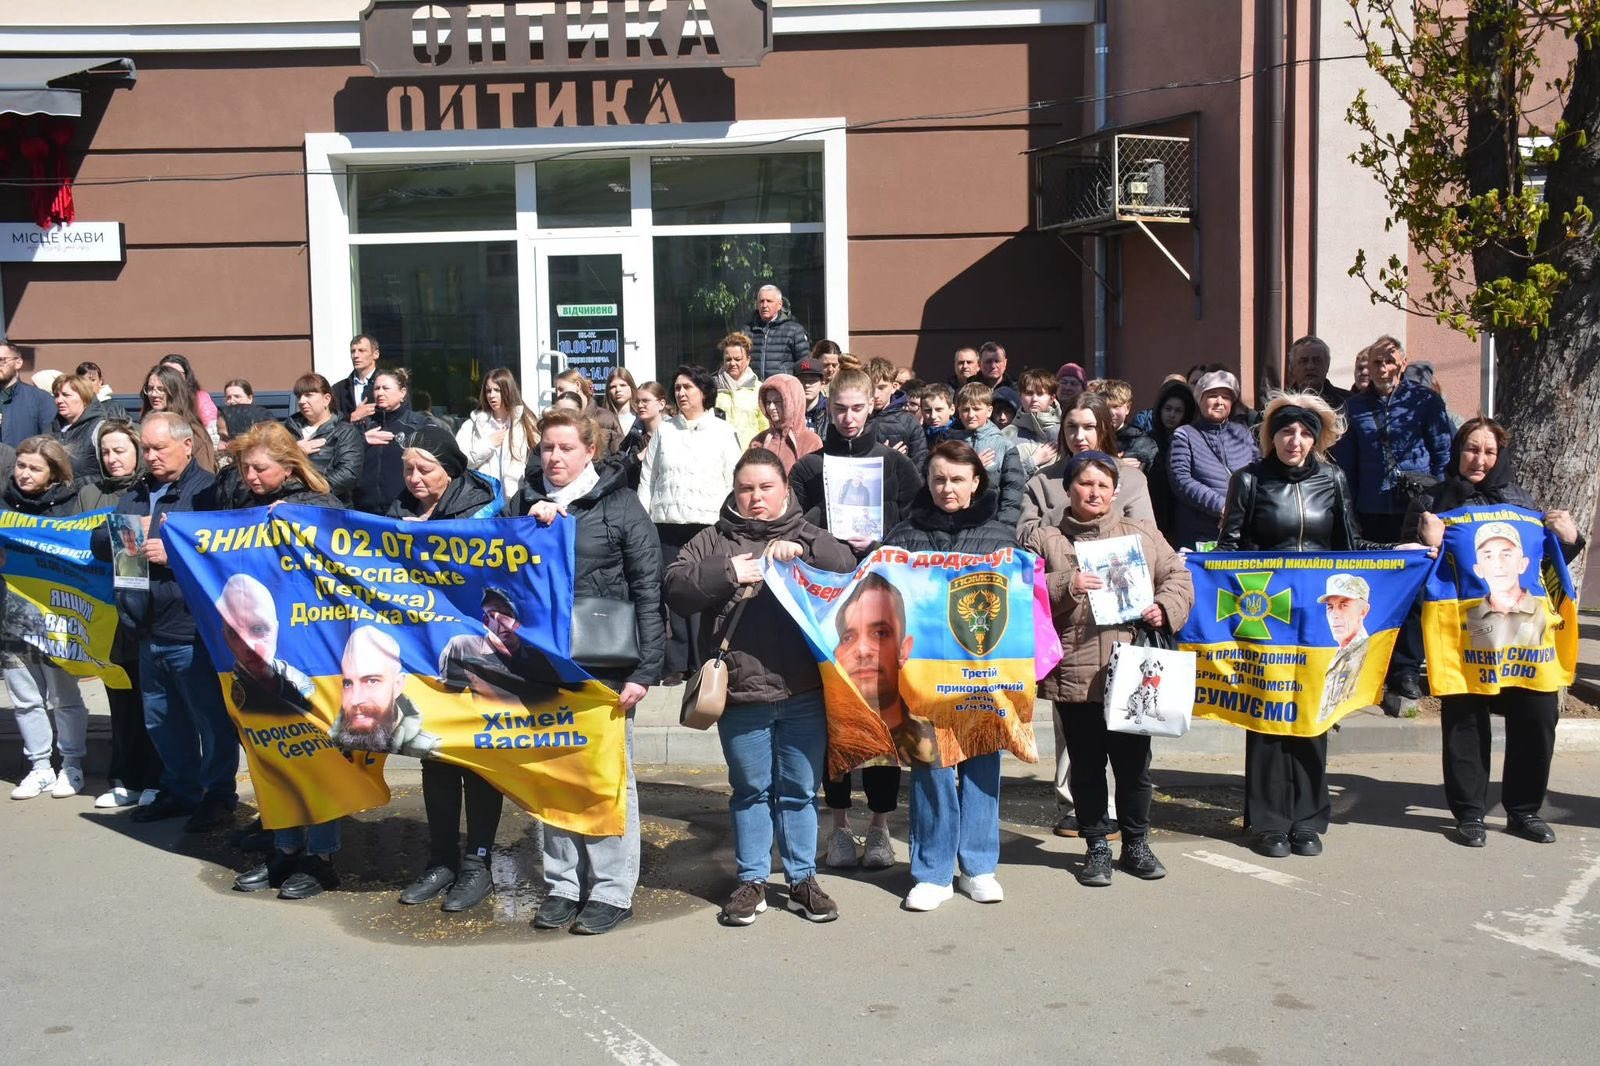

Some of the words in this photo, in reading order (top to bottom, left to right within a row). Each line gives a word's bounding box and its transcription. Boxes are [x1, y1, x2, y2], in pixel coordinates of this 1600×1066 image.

[411, 1, 721, 66] ОПТИКА
[12, 232, 59, 245] МІСЦЕ
[64, 232, 104, 244] КАВИ
[562, 305, 614, 315] ВІДЧИНЕНО
[194, 519, 318, 554] ЗНИКЛИ
[280, 555, 301, 572] с.
[304, 551, 467, 587] Новоспаське
[1285, 556, 1334, 570] МИХАЙЛО
[1335, 558, 1406, 570] ВАСИЛЬОВИЧ
[953, 572, 1005, 586] ПОМСТА
[289, 601, 404, 627] Донецька
[976, 645, 984, 654] 3
[1215, 648, 1308, 666] ПРИКОРДОННИЙ
[961, 667, 998, 680] Третій
[1233, 661, 1265, 677] ЗАГІН
[1479, 668, 1499, 684] ЗА
[1195, 669, 1245, 687] БРИГАДА
[936, 681, 1024, 695] прикордонний
[1194, 685, 1299, 723] СУМУЄМО
[482, 706, 575, 733] Хімей
[473, 729, 589, 750] Василь
